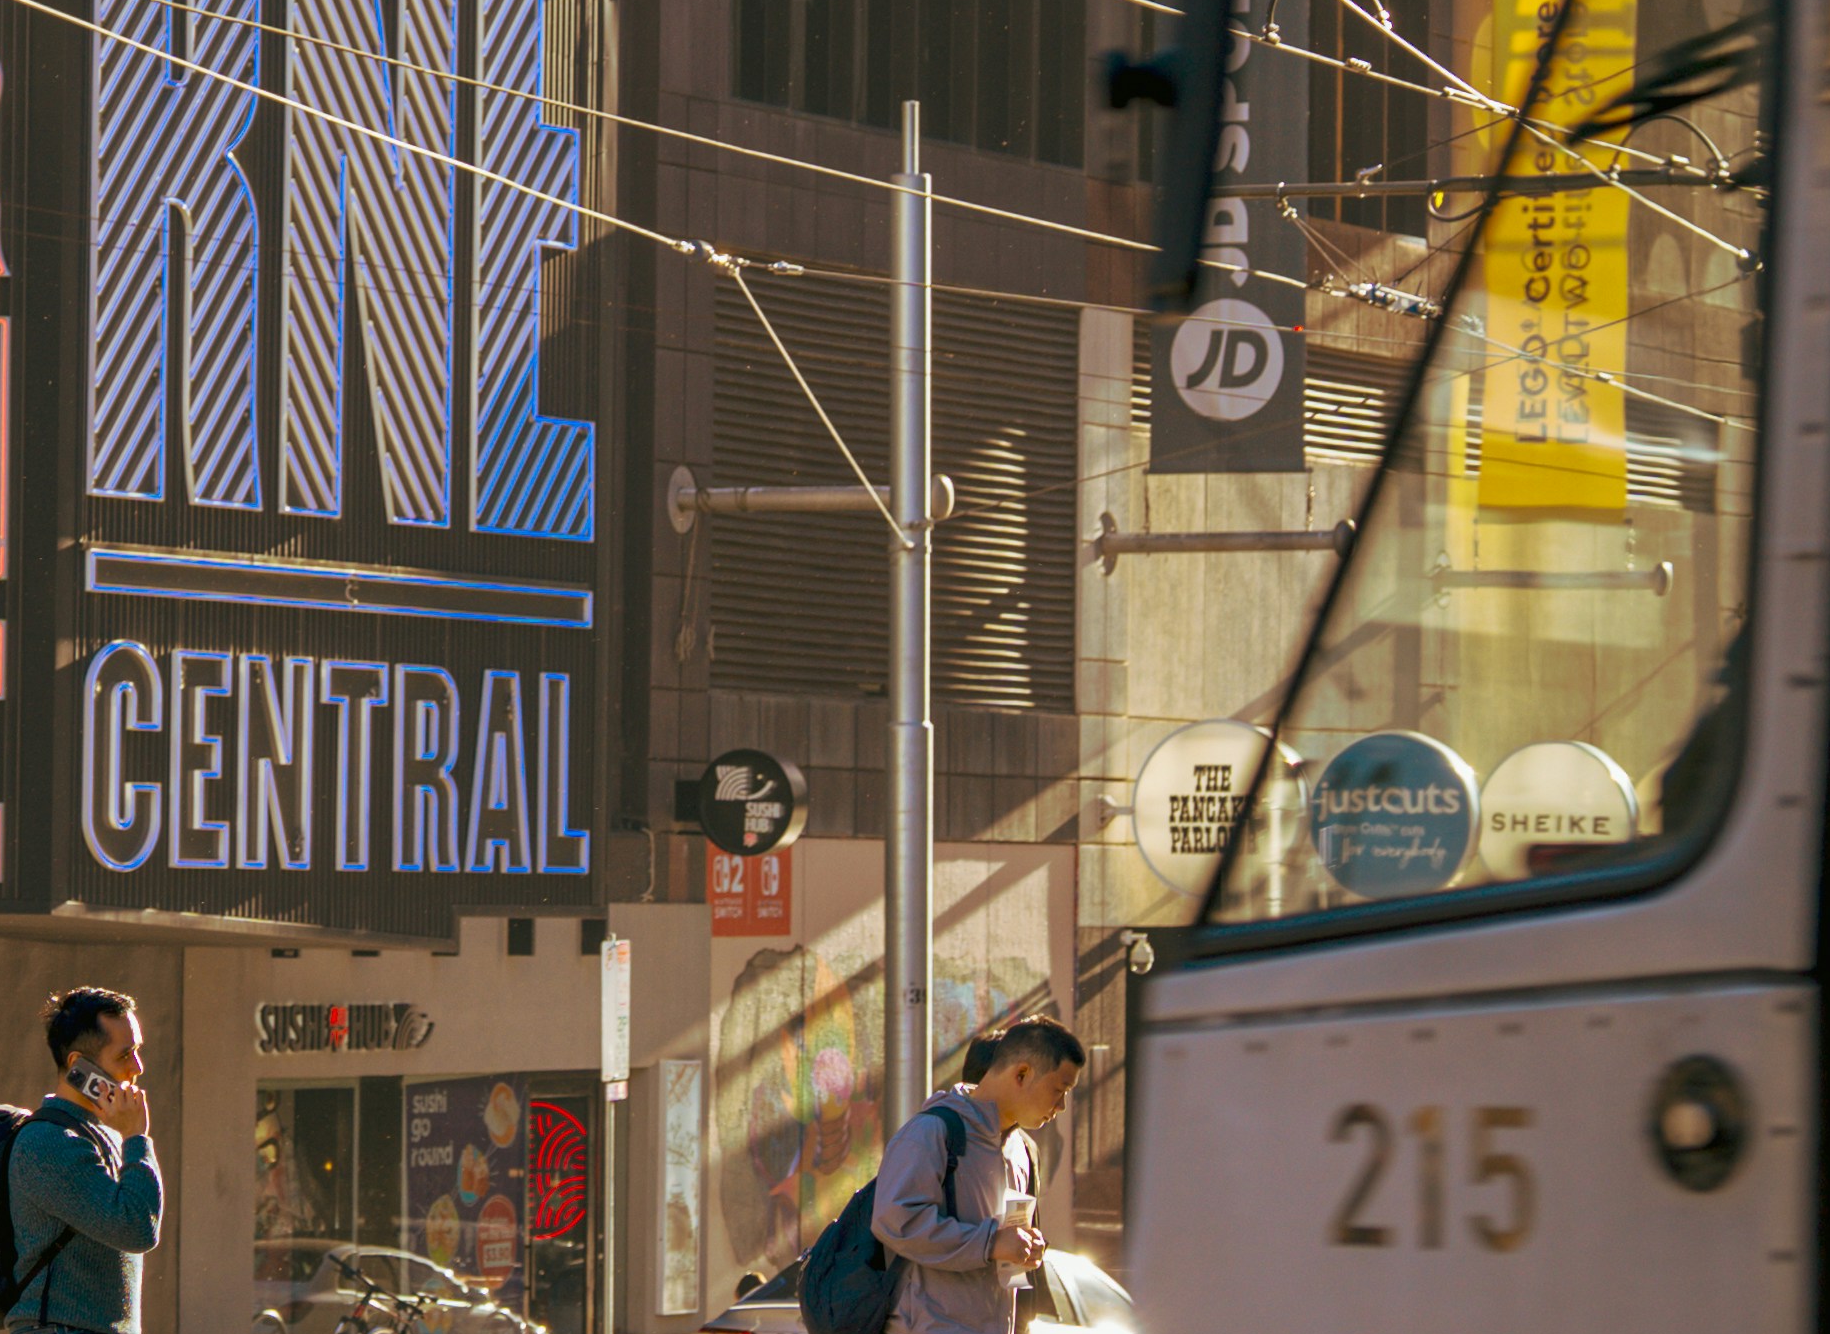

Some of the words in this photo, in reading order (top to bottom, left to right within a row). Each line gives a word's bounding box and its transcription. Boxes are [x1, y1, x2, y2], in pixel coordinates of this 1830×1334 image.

[1186, 347, 1269, 390] JD
[82, 638, 590, 875] CENTRAL
[1193, 764, 1232, 793] THE
[744, 801, 781, 818] SUSHI
[1169, 795, 1252, 823] PANCAK
[744, 817, 772, 833] HUB
[1491, 811, 1612, 836] SHEIKE
[1170, 825, 1259, 854] PARLO
[412, 1090, 448, 1114] sushi
[410, 1117, 432, 1142] go
[410, 1141, 454, 1167] round
[1328, 1104, 1537, 1254] 215
